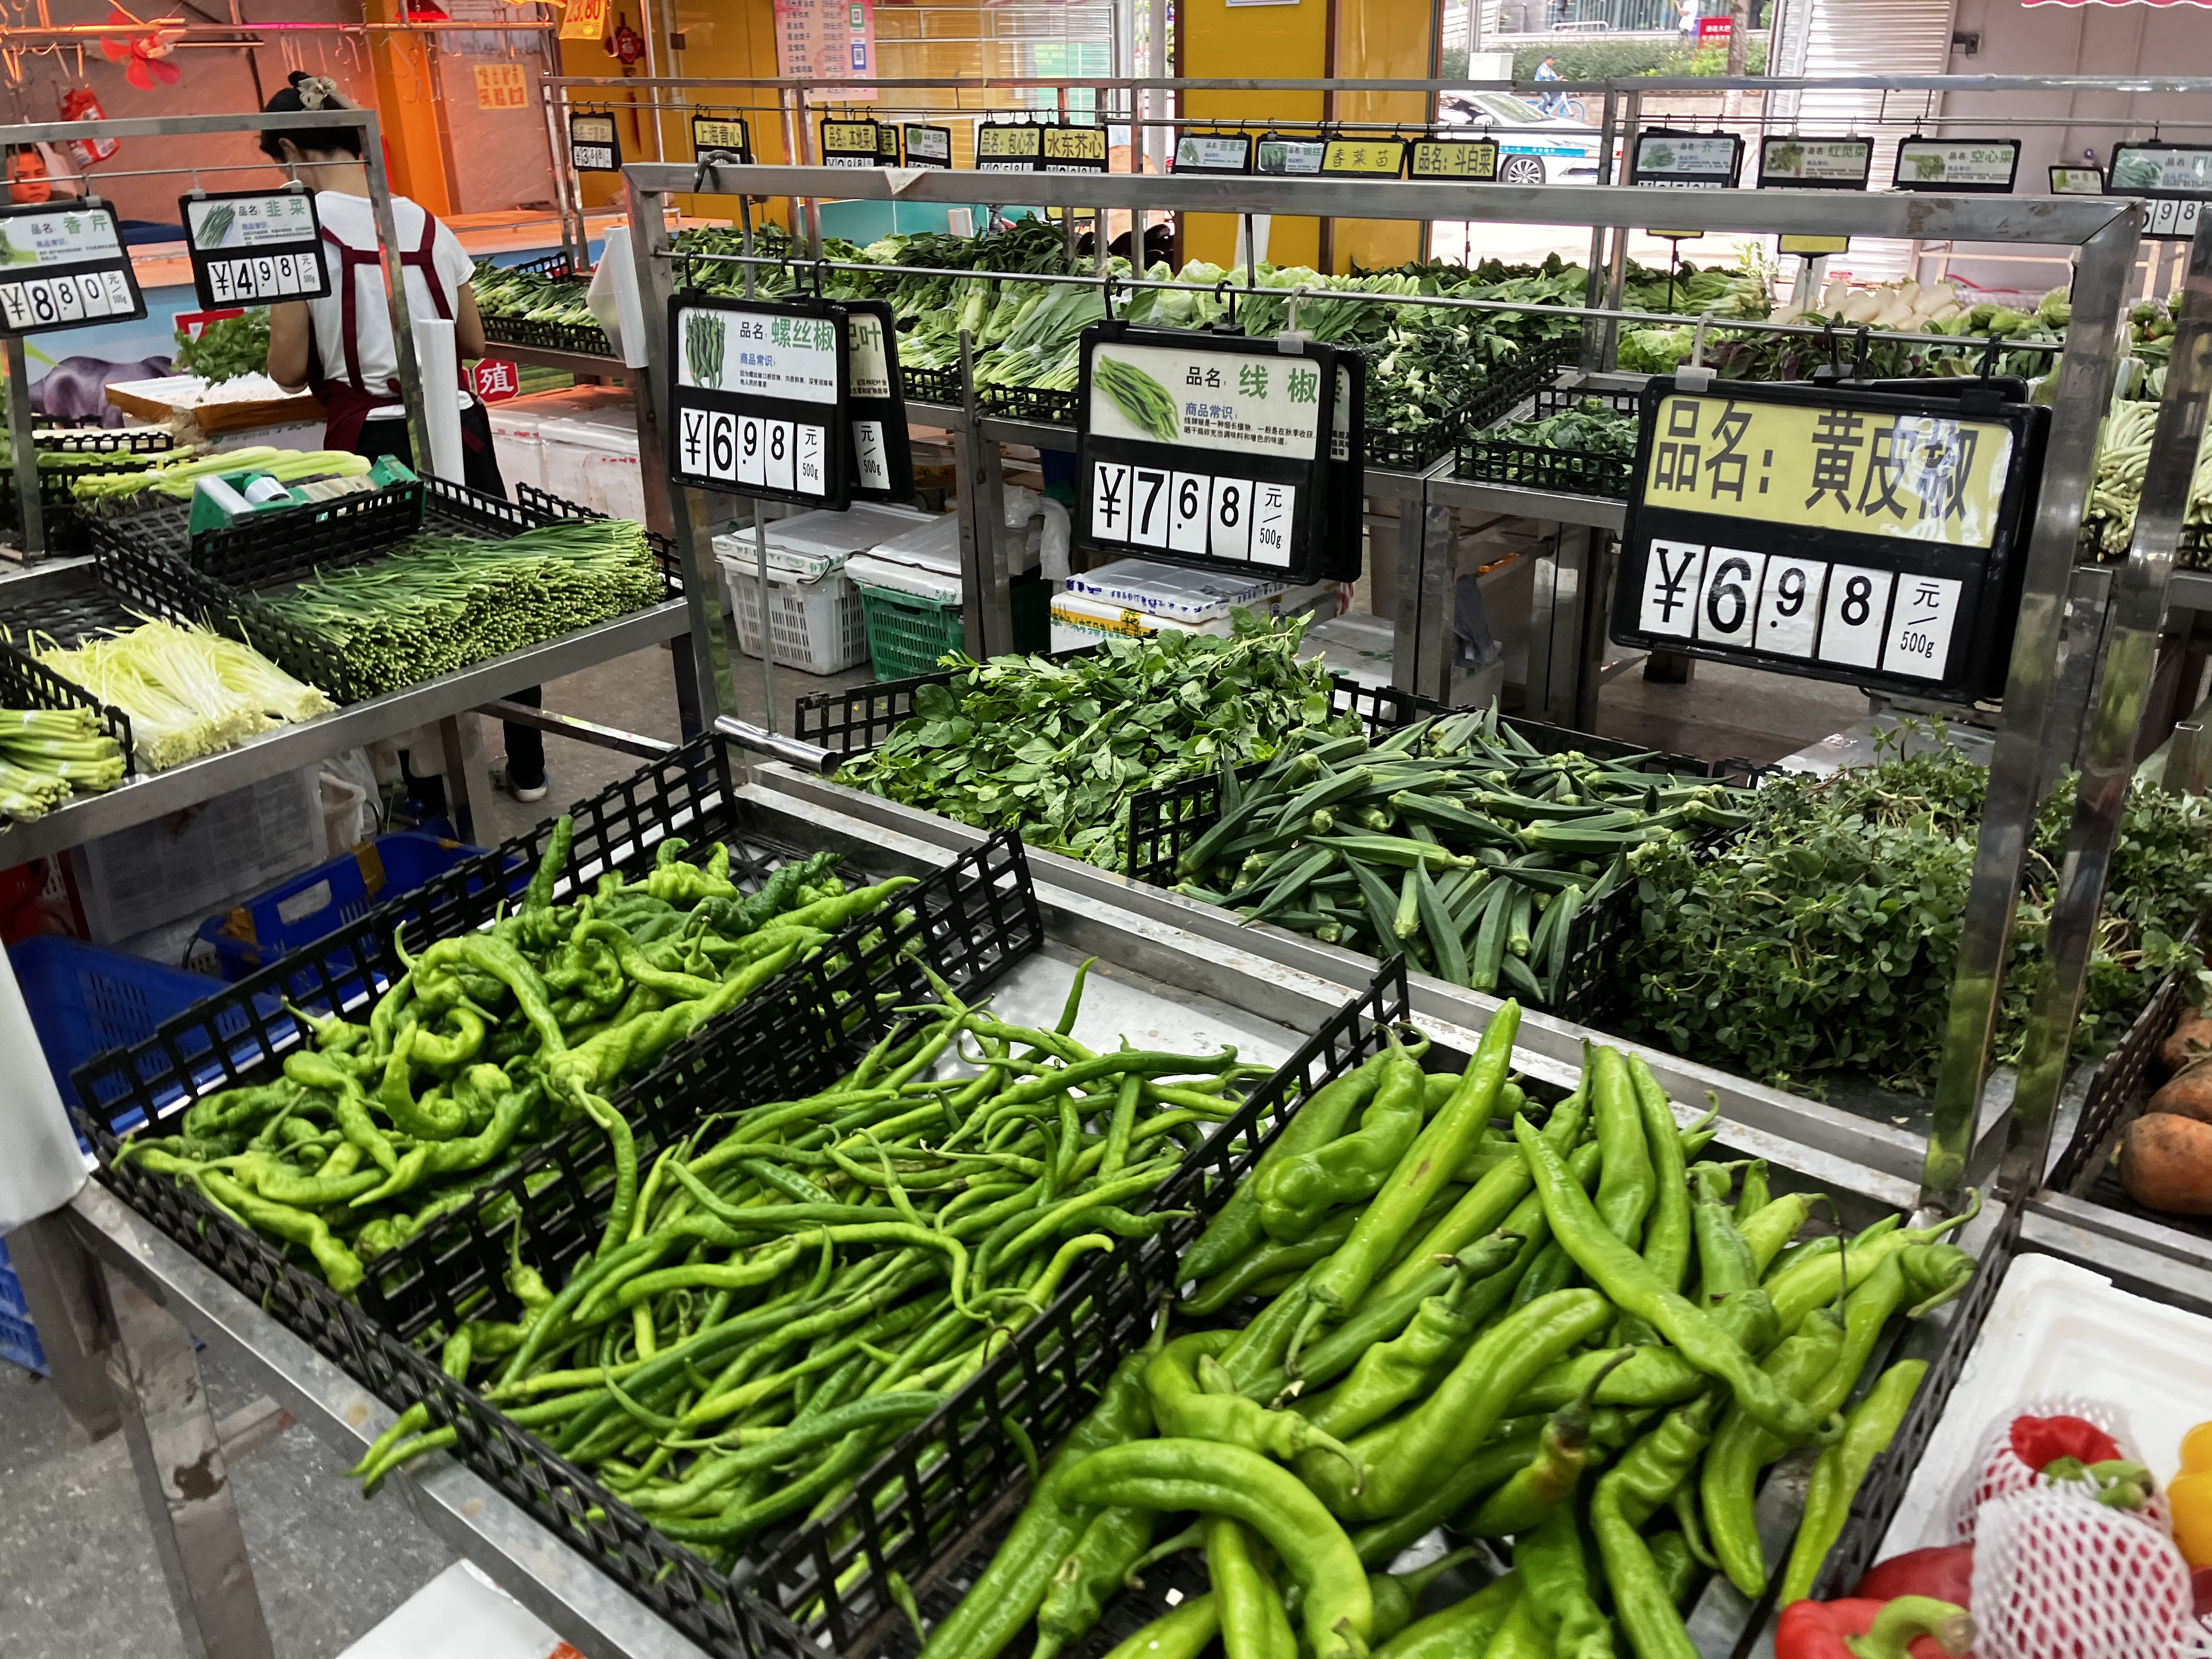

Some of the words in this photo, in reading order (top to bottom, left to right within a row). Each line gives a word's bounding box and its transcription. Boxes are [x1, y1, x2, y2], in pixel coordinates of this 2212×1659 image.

[1008, 131, 1035, 155] 包心芥
[1047, 132, 1103, 158] 水东芥心
[1220, 141, 1247, 151] 苦麦菜
[1702, 140, 1731, 153] 芥兰
[1333, 147, 1389, 167] 春菜苗
[1454, 145, 1493, 174] 斗白菜
[1970, 149, 2013, 163] 空心菜
[266, 198, 305, 217] 韭菜
[63, 215, 108, 234] 香芹
[771, 316, 834, 352] 螺丝椒
[479, 362, 515, 394] 殖
[863, 459, 882, 476] 500g
[1653, 398, 1774, 502] 品名：
[1805, 409, 1980, 522] 黄皮椒
[803, 462, 819, 480] 500g
[1260, 527, 1282, 549] 500g
[1900, 631, 1935, 659] 500g
